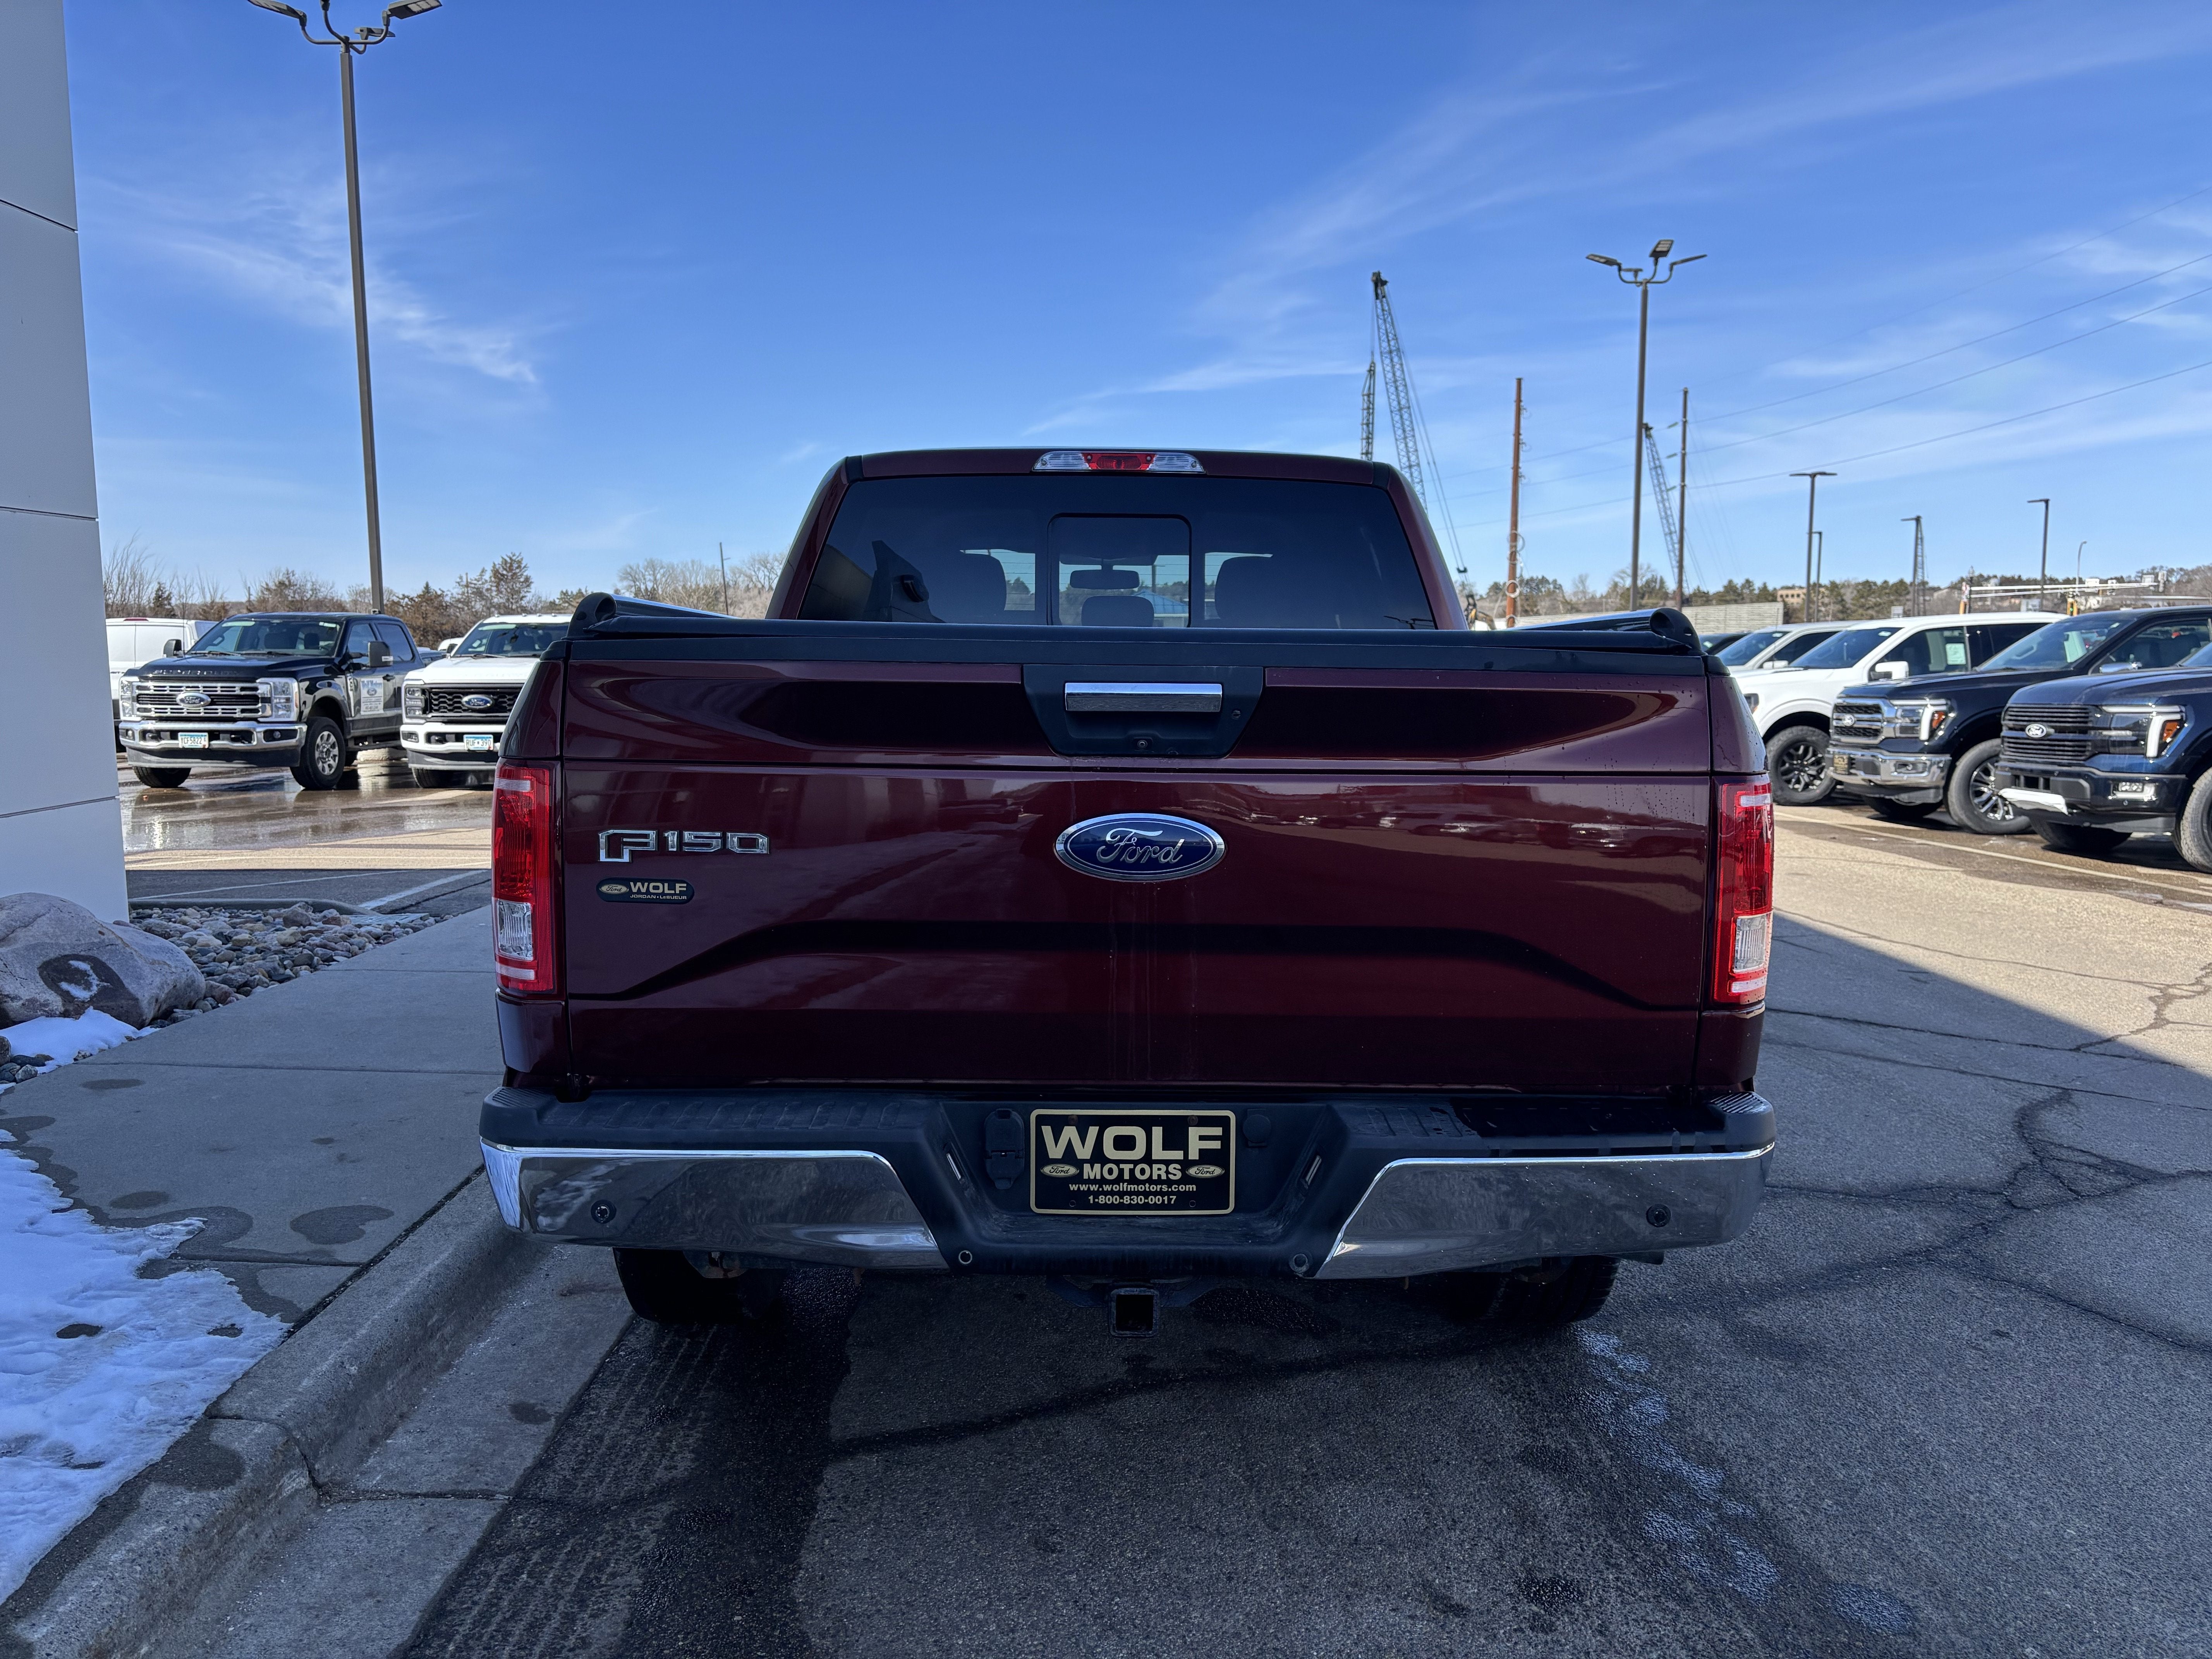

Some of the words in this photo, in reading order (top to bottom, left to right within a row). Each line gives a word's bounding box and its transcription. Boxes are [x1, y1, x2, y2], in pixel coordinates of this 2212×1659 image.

[1096, 828, 1185, 864] Ford
[630, 882, 687, 893] WOLF
[1041, 1125, 1223, 1160] WOLF
[1049, 1166, 1070, 1174] Ford
[1084, 1163, 1182, 1180] MOTORS
[1195, 1167, 1215, 1175] Ford
[1069, 1183, 1196, 1192] www.wolfmotors.com
[1089, 1195, 1176, 1204] 1-800-830-0017
